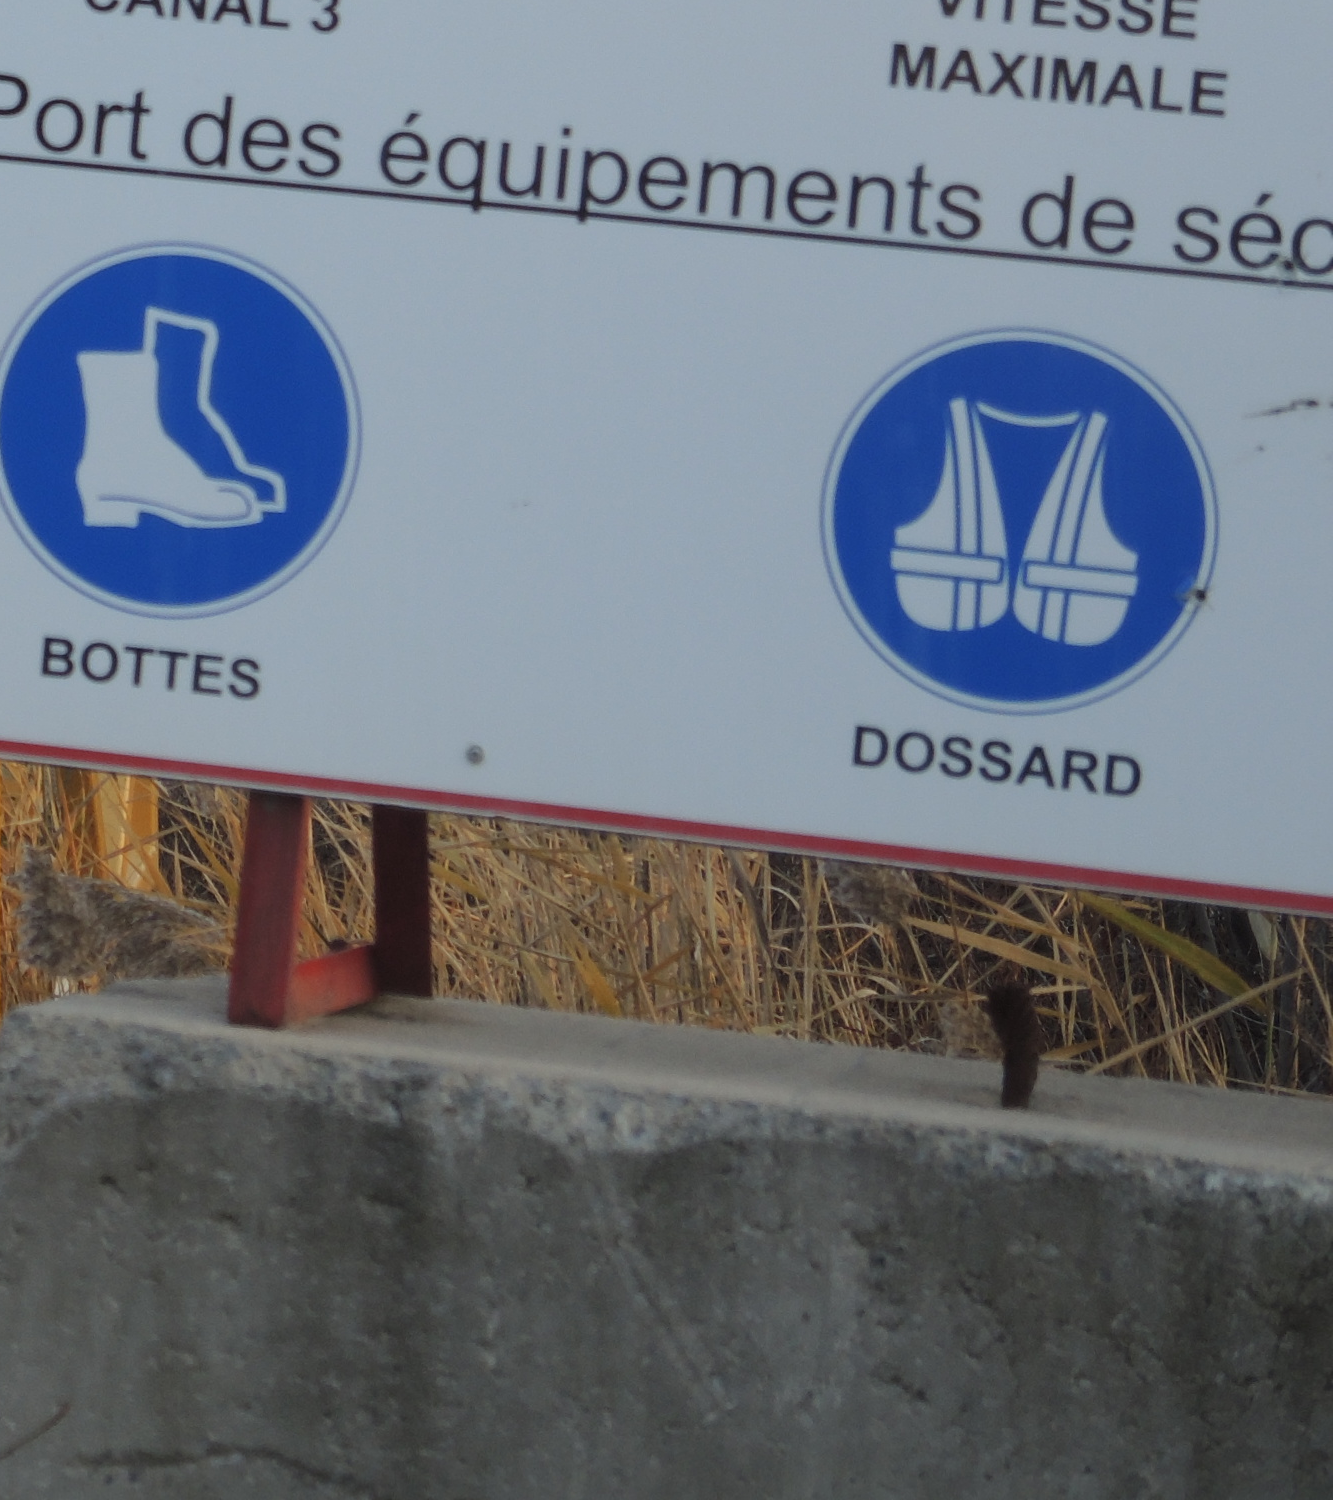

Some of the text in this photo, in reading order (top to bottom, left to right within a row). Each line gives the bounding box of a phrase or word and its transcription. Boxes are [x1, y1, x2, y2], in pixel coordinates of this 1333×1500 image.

[889, 43, 1228, 118] MAXIMALE
[182, 94, 343, 178] des
[379, 111, 982, 241] équipements
[1020, 174, 1135, 255] de
[40, 636, 261, 700] BOTTES
[851, 724, 1141, 798] DOSSARD
